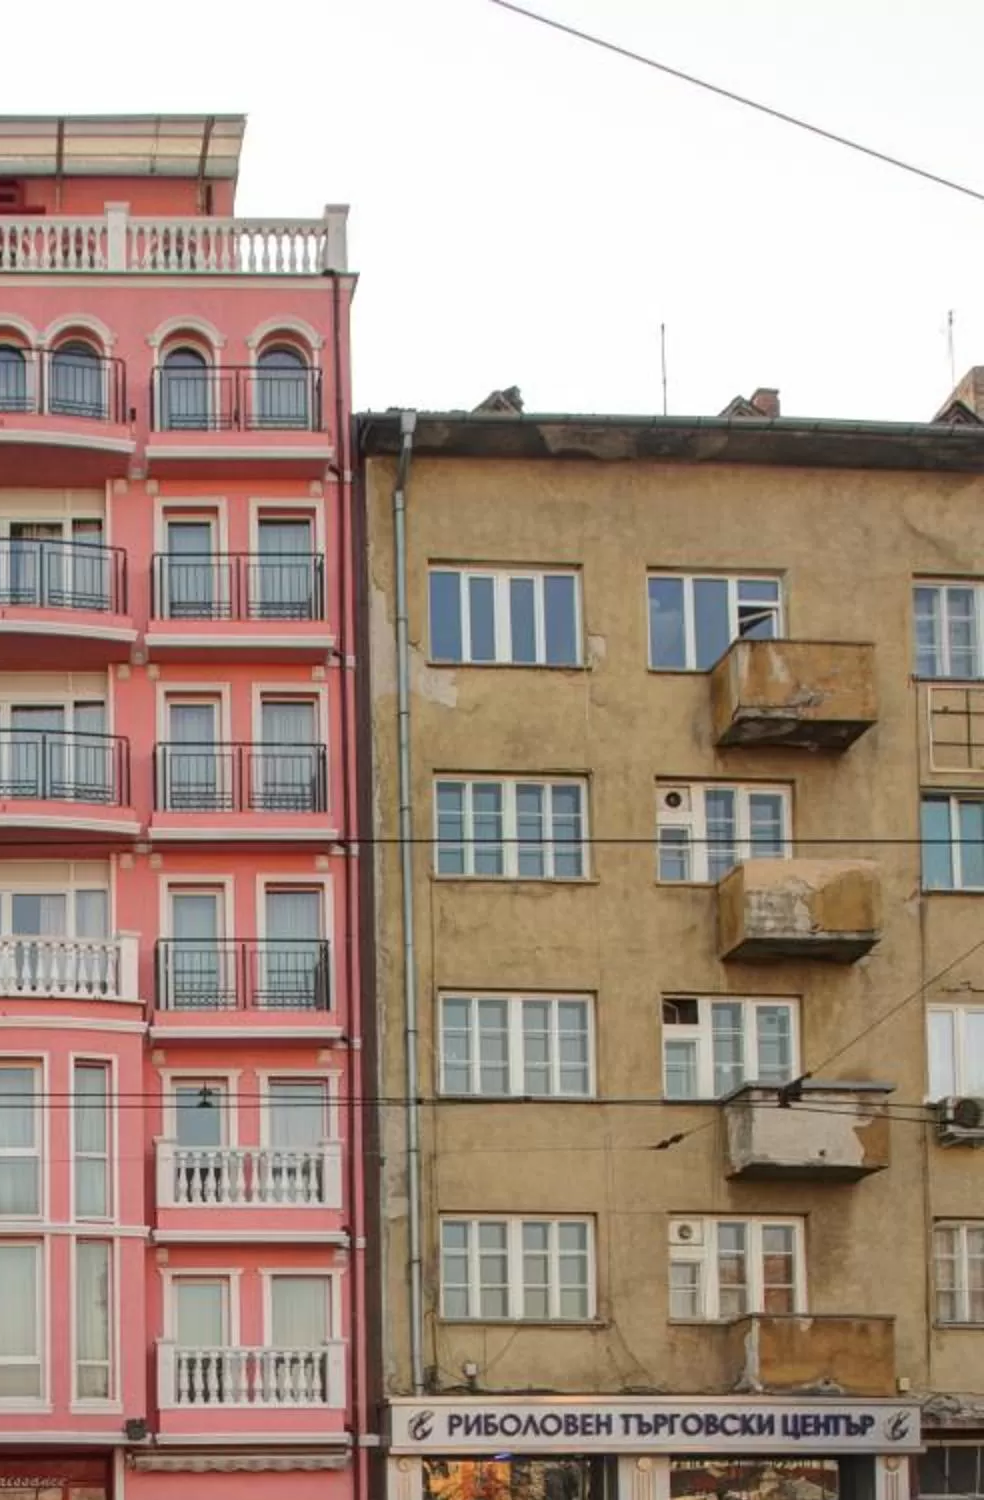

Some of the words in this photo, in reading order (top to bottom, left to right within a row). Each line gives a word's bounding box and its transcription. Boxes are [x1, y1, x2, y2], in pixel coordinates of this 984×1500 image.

[447, 1413, 613, 1437] РИБОЛОВЕН
[620, 1413, 775, 1437] ТЪРГОВСКИ
[781, 1413, 876, 1440] ЦЕНТЪР
